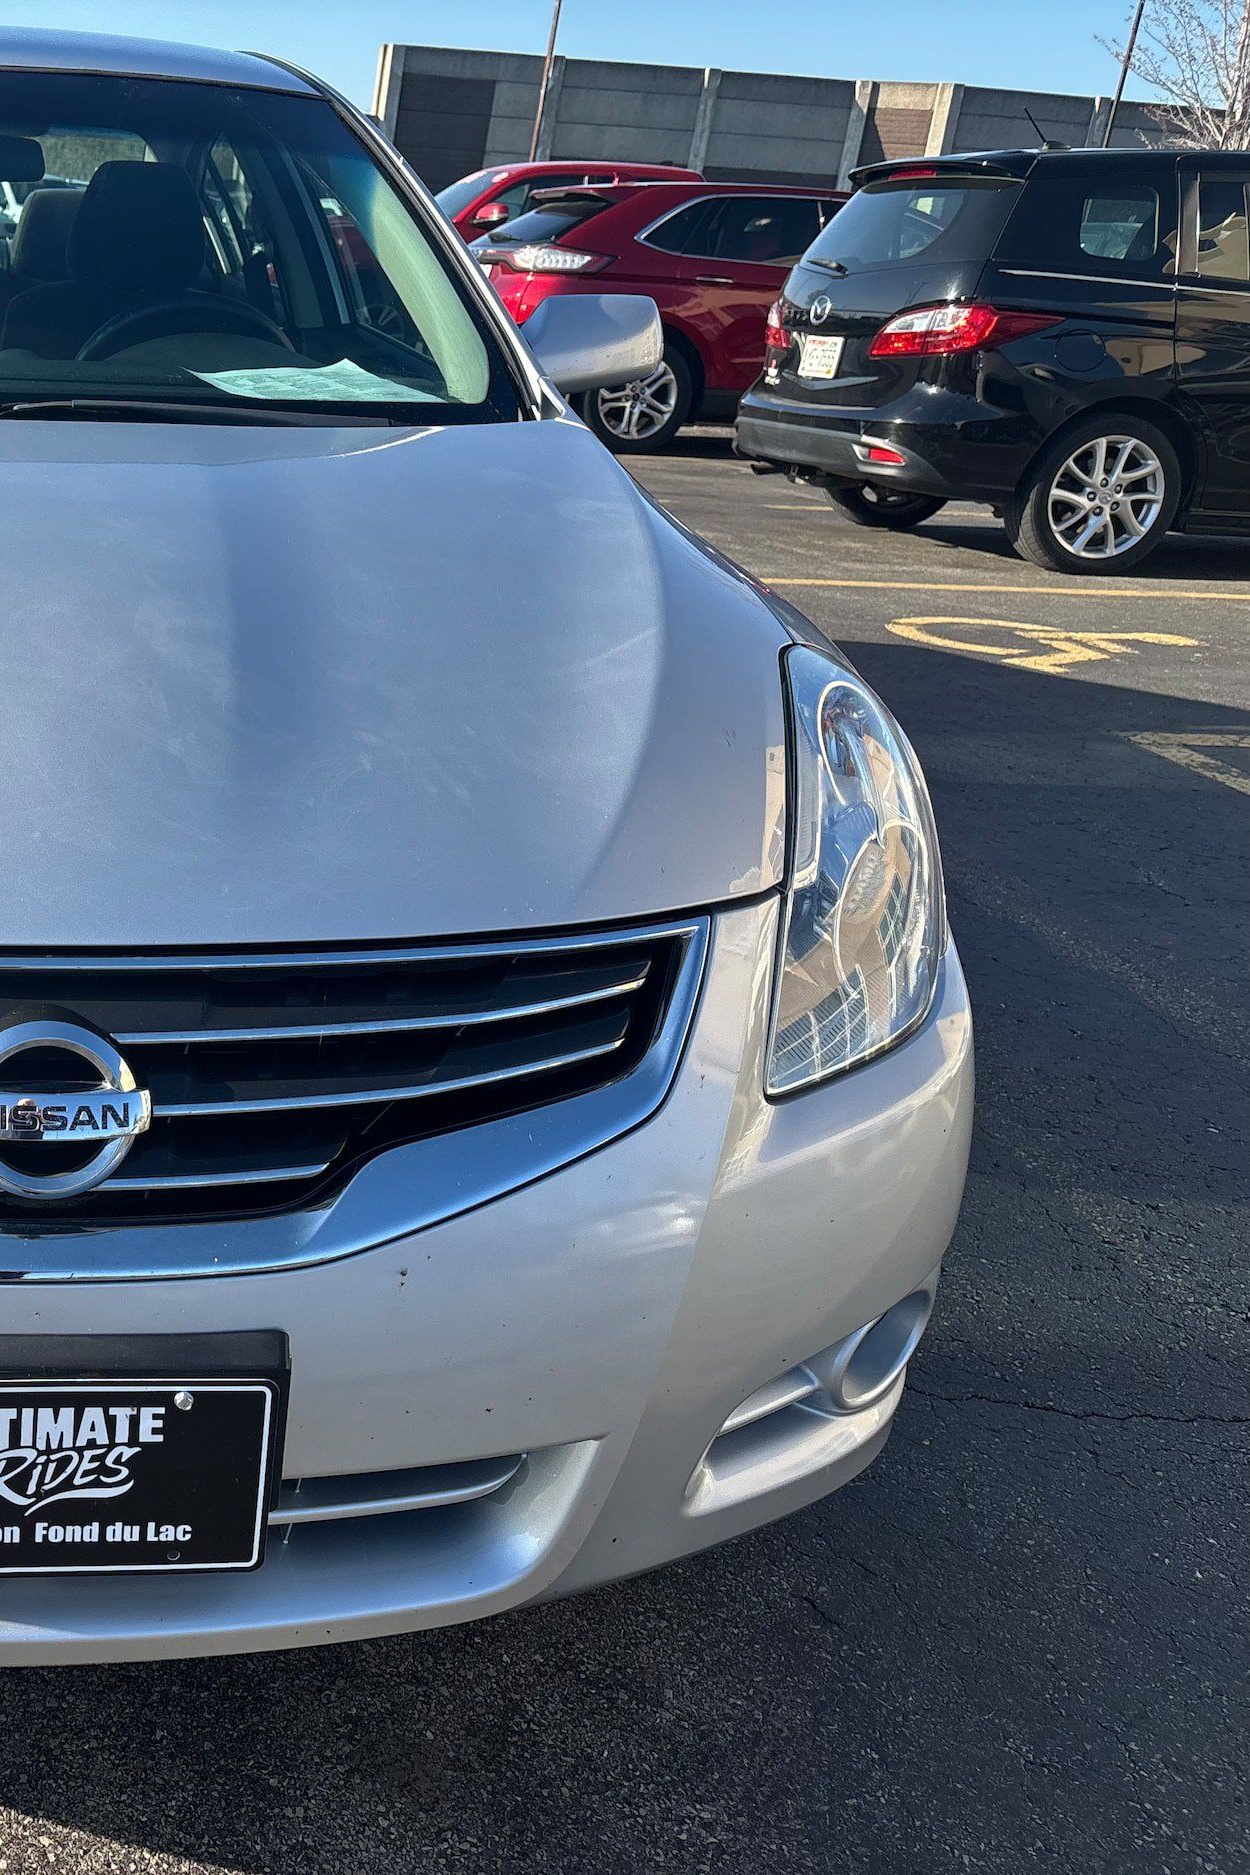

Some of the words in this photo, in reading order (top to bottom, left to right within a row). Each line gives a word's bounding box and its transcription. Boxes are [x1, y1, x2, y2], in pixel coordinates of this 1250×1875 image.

[34, 1521, 100, 1543] Fond
[105, 1521, 141, 1543] du
[146, 1521, 193, 1542] Lac
